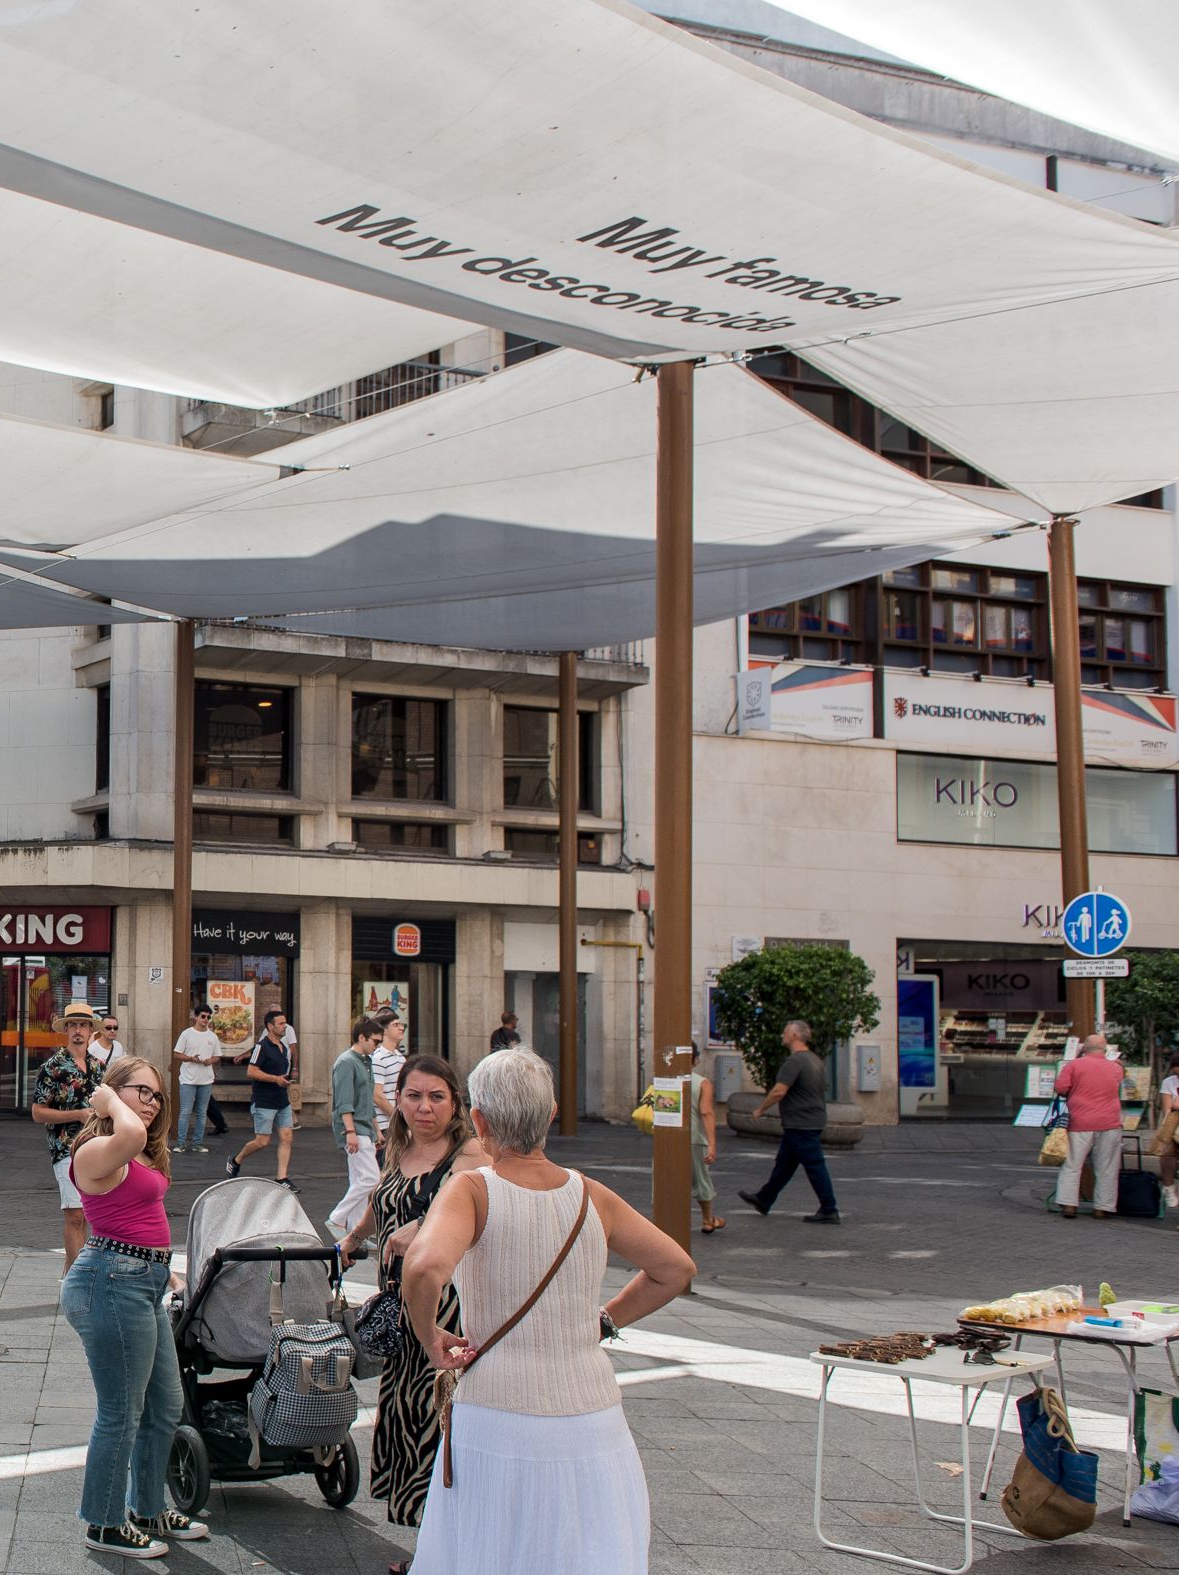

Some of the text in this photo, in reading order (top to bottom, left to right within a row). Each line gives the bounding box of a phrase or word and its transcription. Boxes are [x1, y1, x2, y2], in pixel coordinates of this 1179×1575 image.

[314, 203, 798, 333] Muy desconocida
[575, 215, 902, 311] Muy famosa
[831, 715, 864, 726] TRINITY
[911, 703, 962, 719] ENGLISH
[1140, 740, 1169, 750] TRINITY
[935, 777, 1018, 808] KIKO
[1023, 904, 1064, 928] KIK
[193, 921, 297, 947] Have it your way
[397, 940, 419, 949] KING
[968, 973, 1030, 990] KIKO
[210, 983, 252, 1005] CBK
